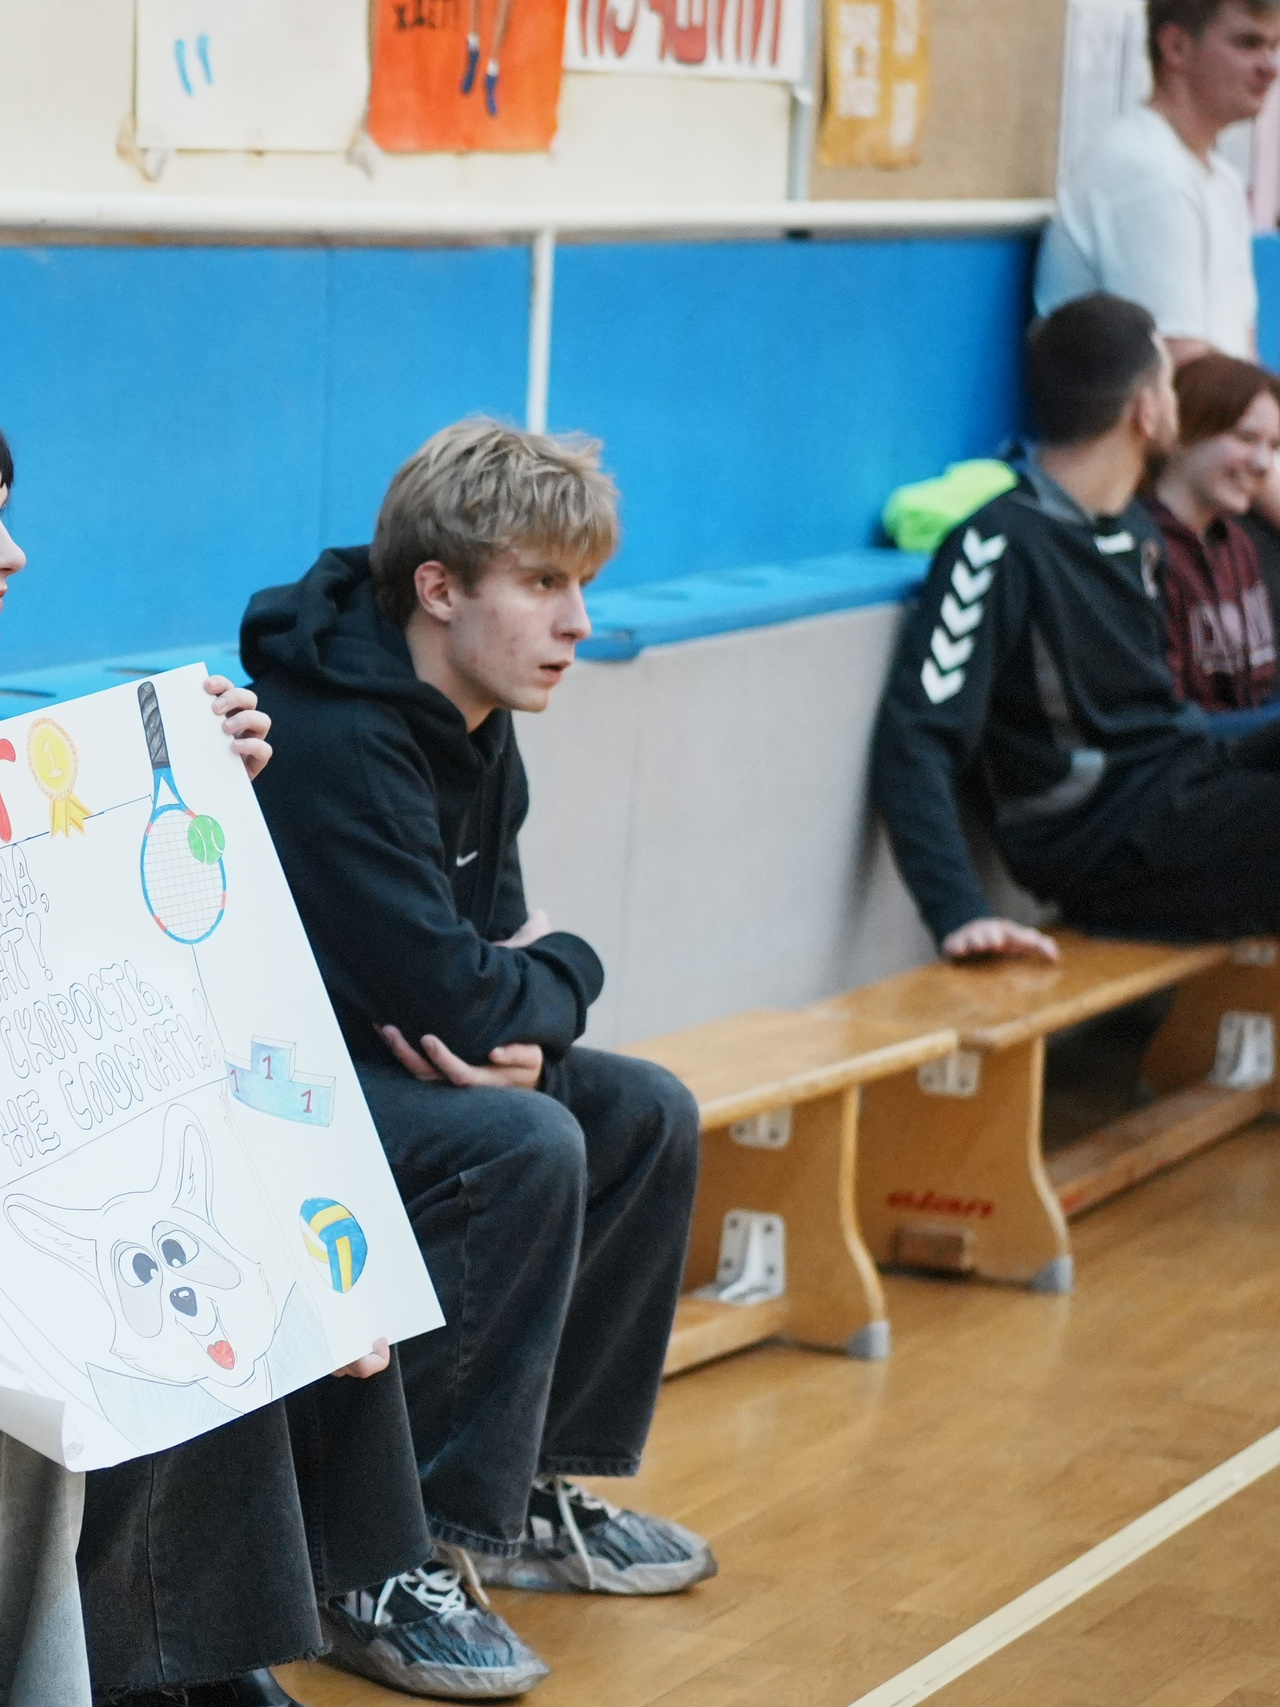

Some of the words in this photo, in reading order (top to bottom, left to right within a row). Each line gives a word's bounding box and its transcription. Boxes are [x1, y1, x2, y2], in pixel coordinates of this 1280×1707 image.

[42, 739, 64, 780] 1
[262, 1054, 274, 1080] 1
[301, 1089, 313, 1114] 1
